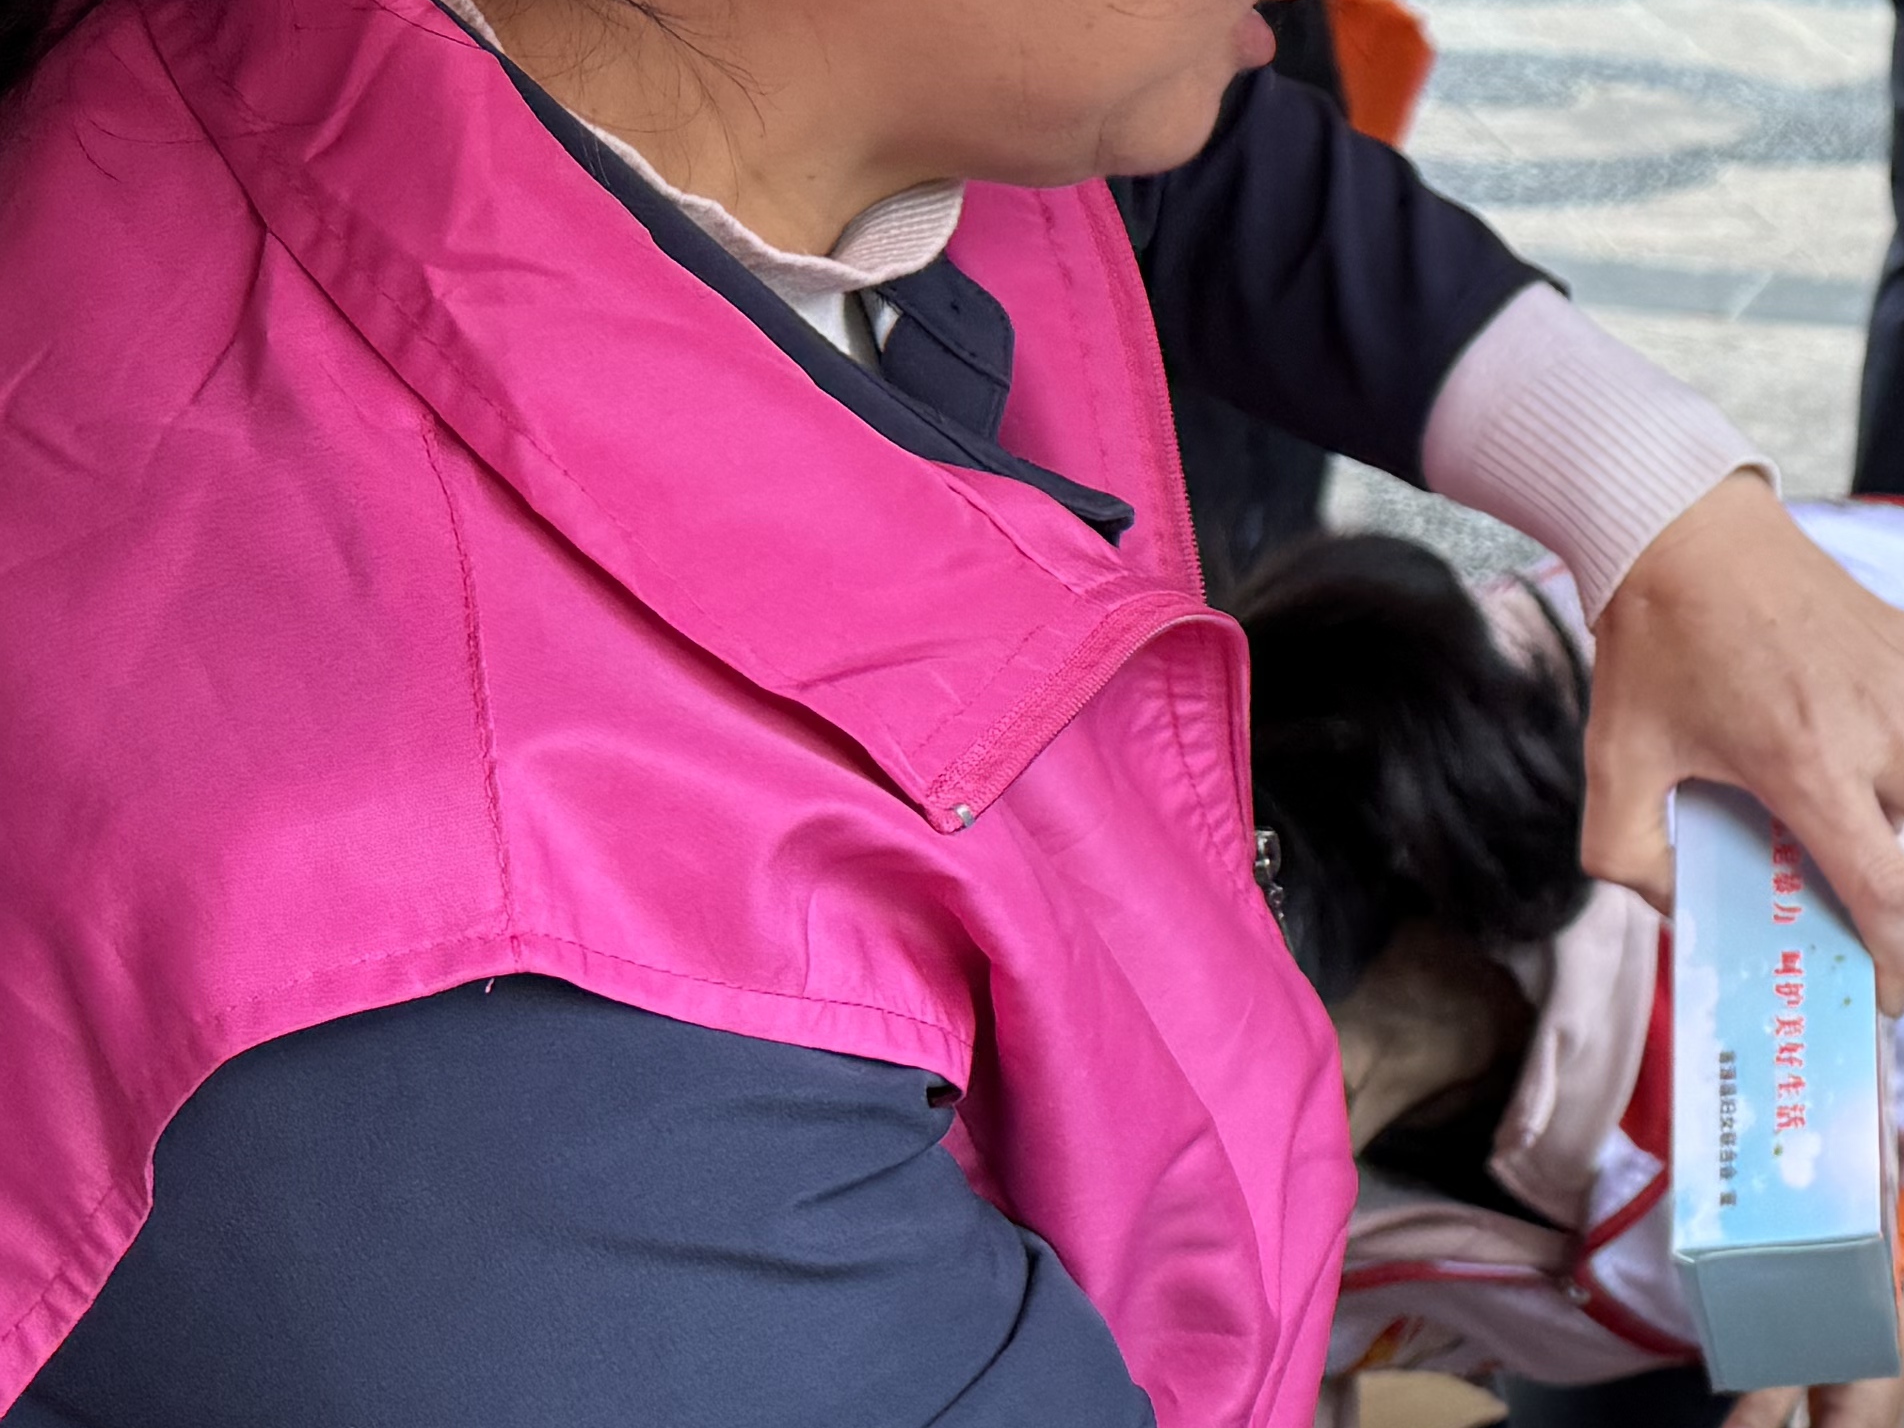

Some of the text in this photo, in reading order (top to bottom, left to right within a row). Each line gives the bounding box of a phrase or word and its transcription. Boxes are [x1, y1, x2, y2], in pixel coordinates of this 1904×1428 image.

[1773, 949, 1806, 1131] 呵护美好生活
